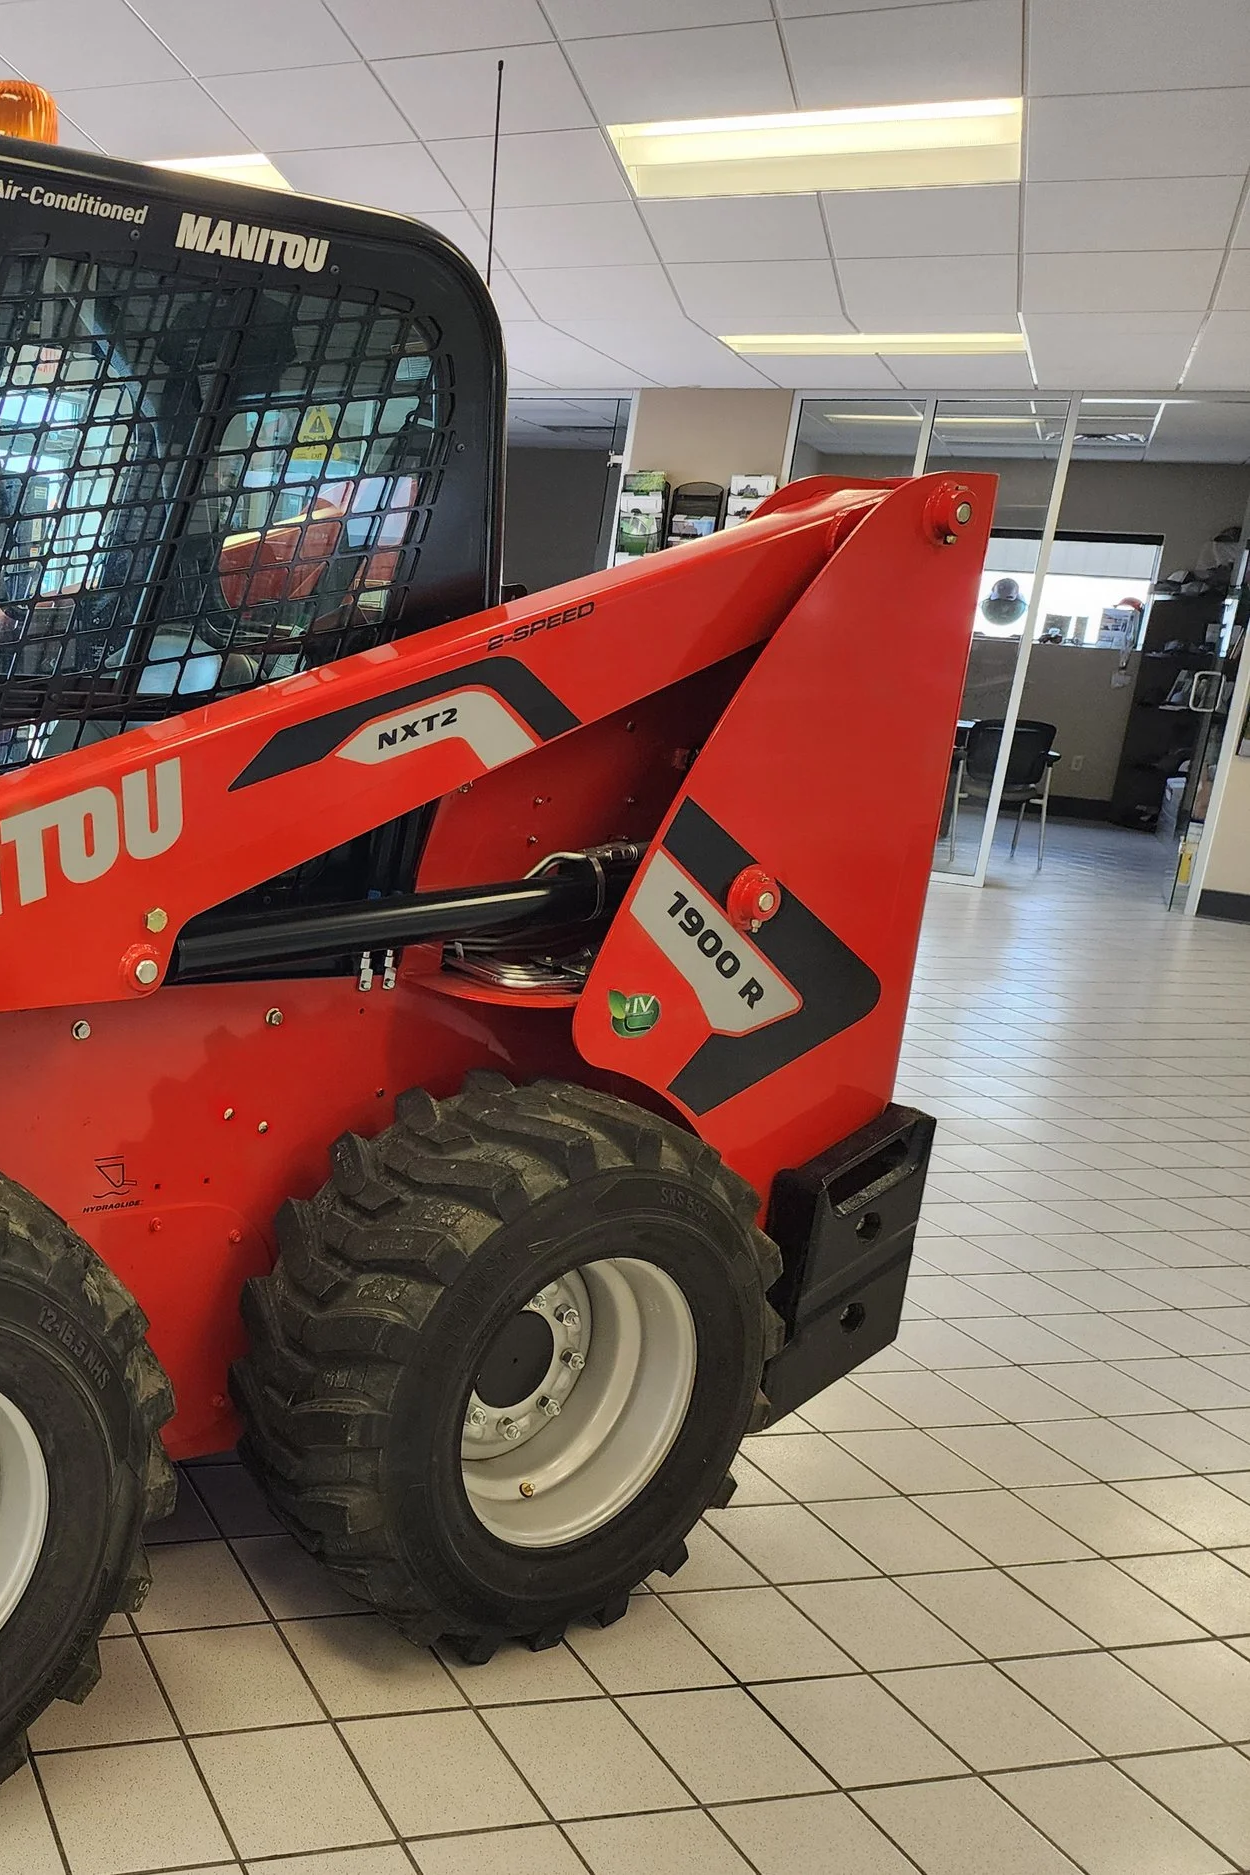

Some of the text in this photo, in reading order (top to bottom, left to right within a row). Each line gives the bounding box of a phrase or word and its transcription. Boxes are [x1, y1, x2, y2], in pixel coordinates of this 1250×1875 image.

[175, 212, 330, 273] MANITOU
[487, 601, 595, 652] 2-SPEED
[377, 707, 458, 750] NXT2
[666, 890, 765, 1010] 1900 R
